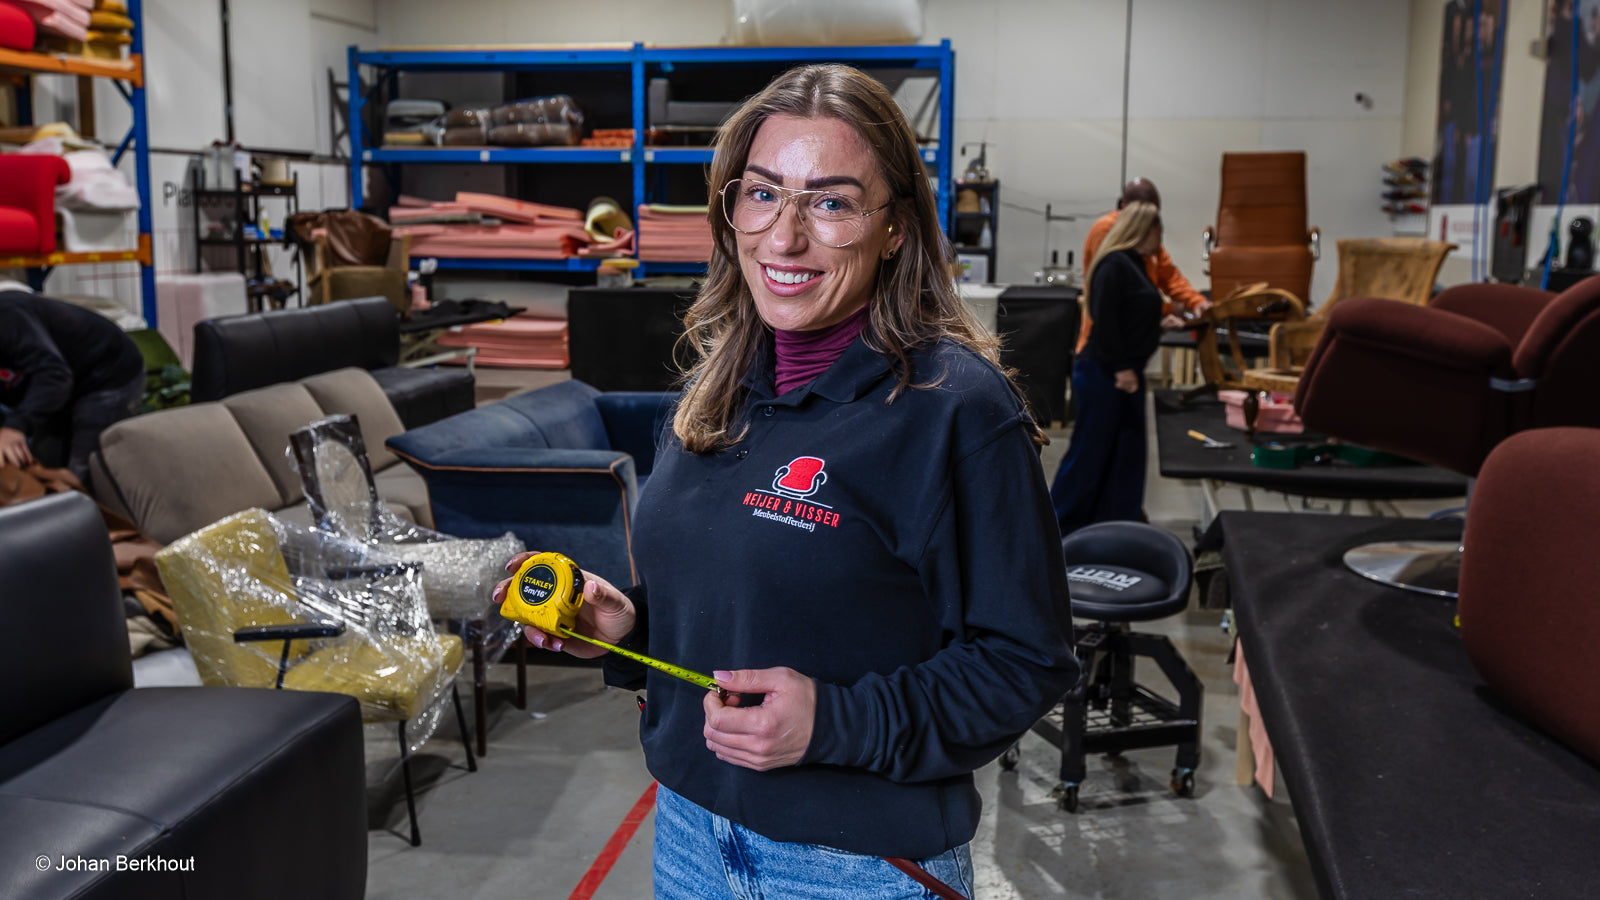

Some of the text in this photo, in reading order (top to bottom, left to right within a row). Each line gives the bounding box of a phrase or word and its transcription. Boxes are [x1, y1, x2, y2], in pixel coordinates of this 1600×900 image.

[783, 500, 793, 514] &
[795, 502, 840, 528] VISSER
[523, 576, 554, 590] STANLEY
